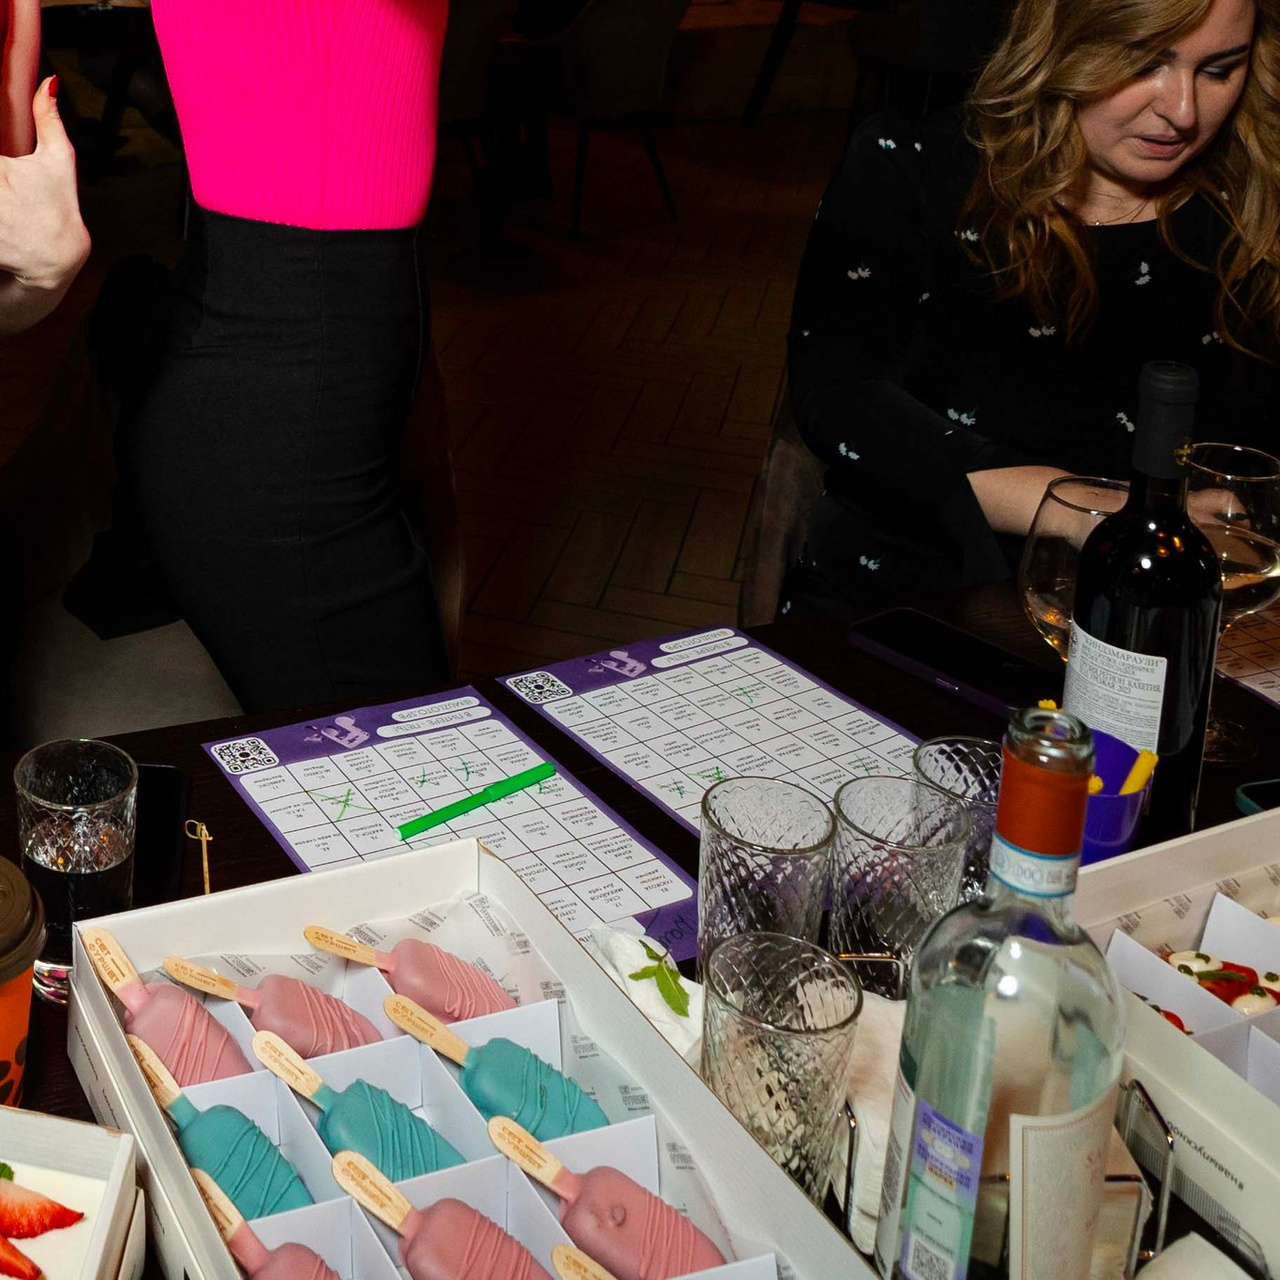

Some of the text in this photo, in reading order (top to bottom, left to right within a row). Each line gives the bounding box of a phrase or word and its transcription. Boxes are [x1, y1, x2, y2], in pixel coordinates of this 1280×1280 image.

[397, 699, 473, 719] @MUZLOTO.SPB
[391, 722, 421, 733] ПЕТЬ!
[426, 713, 464, 727] ПИТЕРЕ
[589, 887, 624, 901] МИХАЙЛОВ
[95, 937, 112, 957] СЕТ
[88, 943, 121, 985] ФУРШЕТ
